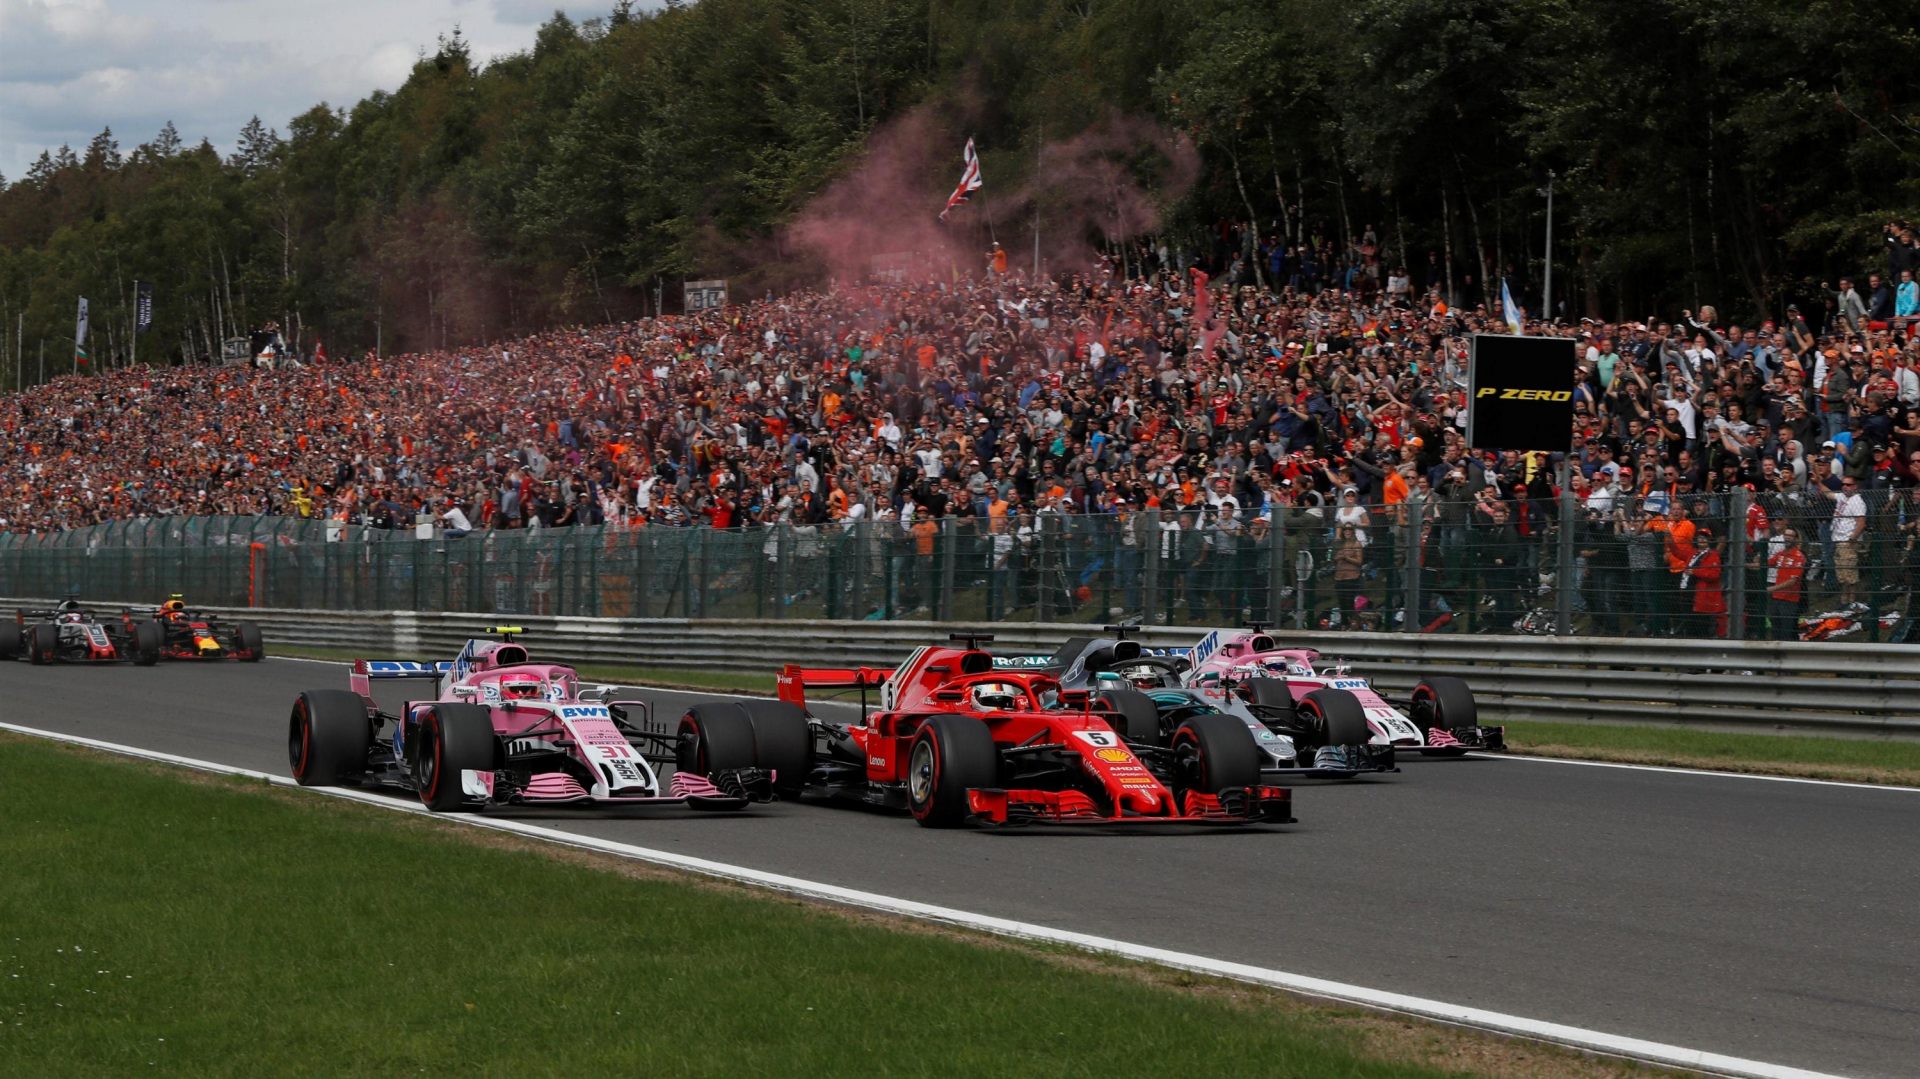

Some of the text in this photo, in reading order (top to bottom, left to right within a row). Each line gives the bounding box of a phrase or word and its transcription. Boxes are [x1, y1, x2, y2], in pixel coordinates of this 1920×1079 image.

[1476, 387, 1572, 402] P ZERO
[1196, 630, 1218, 662] BWT
[1335, 680, 1368, 688] BWT
[562, 707, 609, 718] BWT
[1087, 732, 1110, 746] 5
[597, 746, 631, 759] 31
[869, 755, 886, 767] Lenovo
